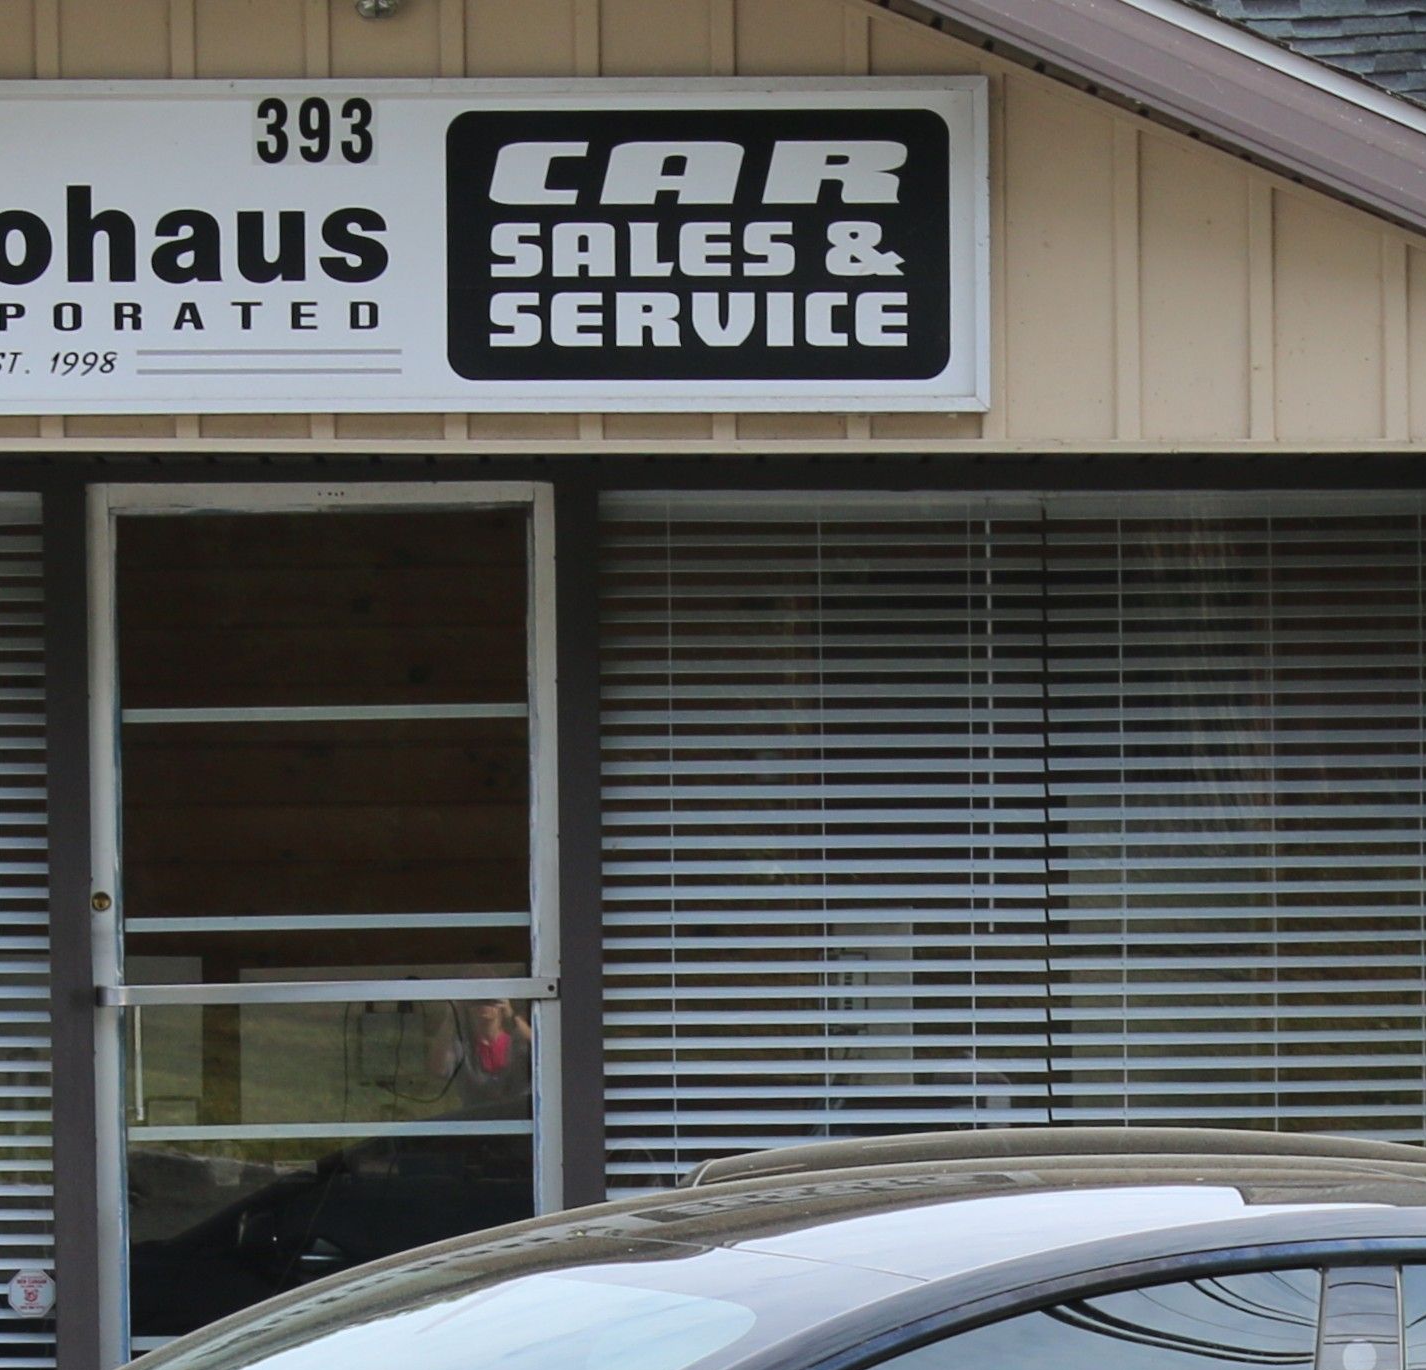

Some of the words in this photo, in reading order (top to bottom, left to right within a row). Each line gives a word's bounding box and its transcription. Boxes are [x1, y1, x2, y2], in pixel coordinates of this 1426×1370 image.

[256, 97, 374, 164] 393
[488, 140, 909, 205] CAR
[490, 221, 796, 278] SALES
[825, 220, 906, 277] &
[489, 291, 909, 347] SERVICE
[49, 352, 118, 375] 1998
